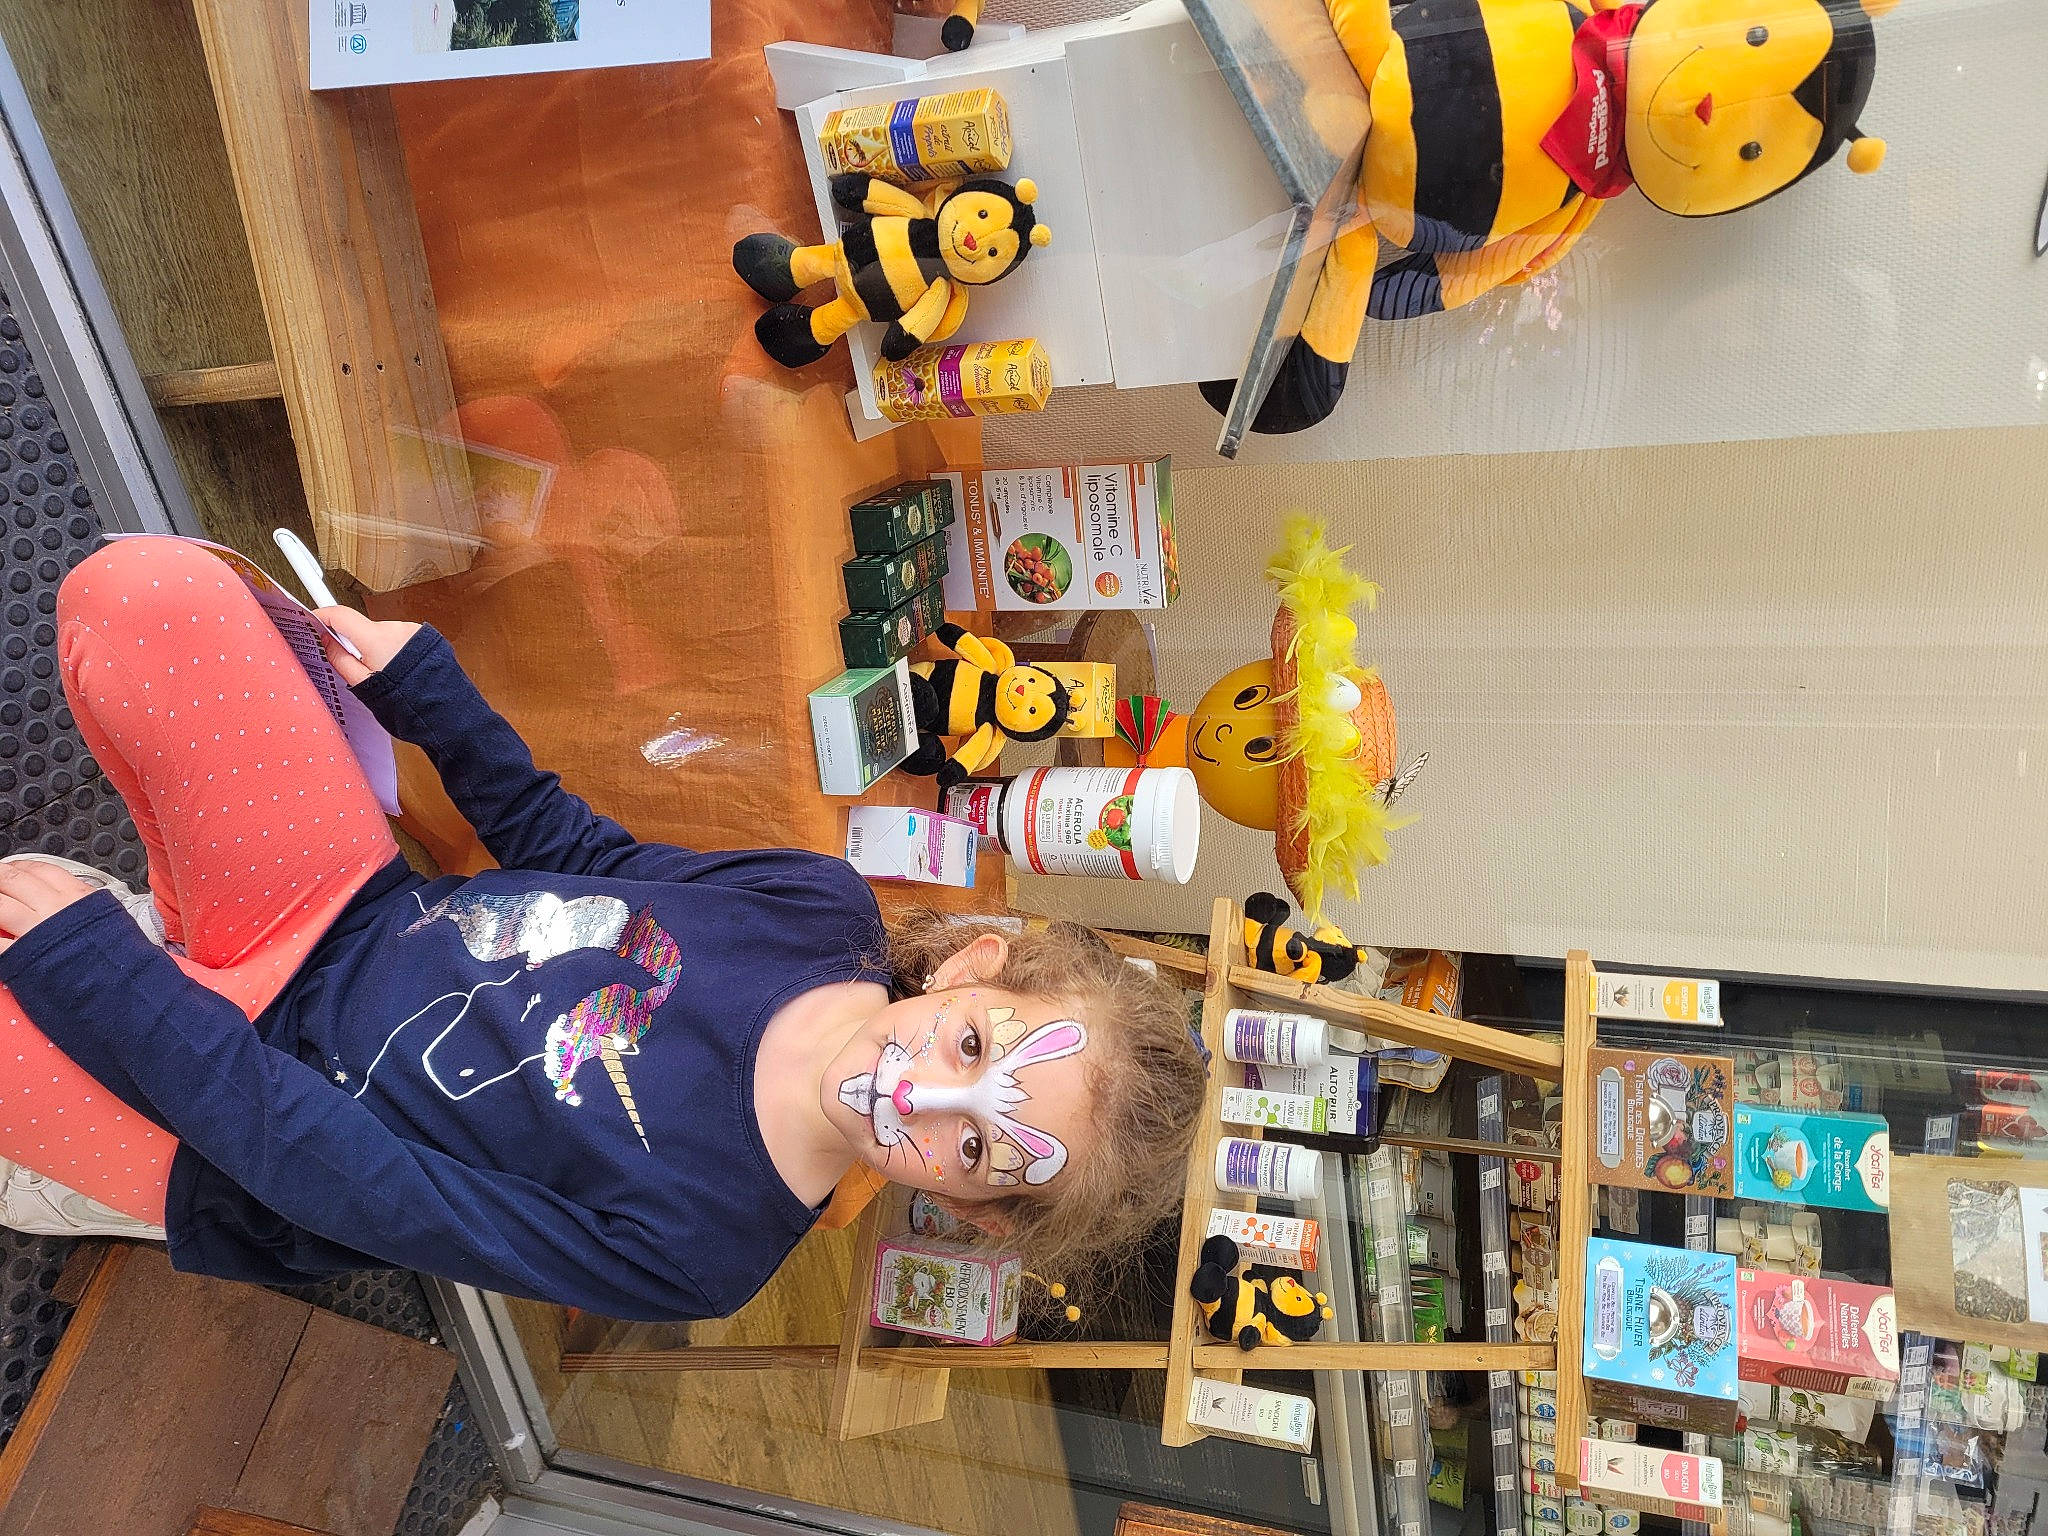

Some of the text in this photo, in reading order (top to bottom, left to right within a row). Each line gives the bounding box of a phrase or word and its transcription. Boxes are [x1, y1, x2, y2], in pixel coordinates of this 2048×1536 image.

[940, 124, 954, 154] extrait
[962, 121, 980, 152] Apicol
[1588, 95, 1599, 154] Propolis
[1592, 70, 1608, 170] Aagaard
[922, 124, 936, 158] Propolis
[934, 136, 942, 146] de
[1005, 364, 1020, 392] Apicol
[994, 478, 1002, 486] de
[1002, 477, 1008, 485] 20
[1036, 475, 1044, 504] Vitamine
[1045, 474, 1054, 514] Complexe
[973, 528, 982, 536] &
[1084, 474, 1106, 562] liposomale
[1104, 473, 1122, 557] Vitamine C
[872, 709, 882, 754] MANUKA
[884, 708, 892, 737] VERTE
[888, 697, 898, 742] PROPOLIS
[1064, 798, 1073, 828] Maxima
[1074, 798, 1084, 845] ACÉROLA
[1346, 1087, 1354, 1122] HORIZON
[1635, 1073, 1645, 1107] TISANE
[1302, 1100, 1310, 1128] VITAMINE
[1708, 1100, 1725, 1154] PROVENCE
[1635, 1128, 1645, 1168] DRUIDES
[1832, 1137, 1843, 1192] de la Gorge
[944, 1286, 955, 1308] BIO
[954, 1262, 972, 1336] REFROIDISSEMENT
[1626, 1290, 1634, 1331] BIOLOGIQUE
[1634, 1278, 1645, 1346] TISANE HIVER
[1710, 1298, 1726, 1348] PROVENCE
[1840, 1303, 1850, 1349] Naturelles
[1850, 1306, 1860, 1348] Défenses
